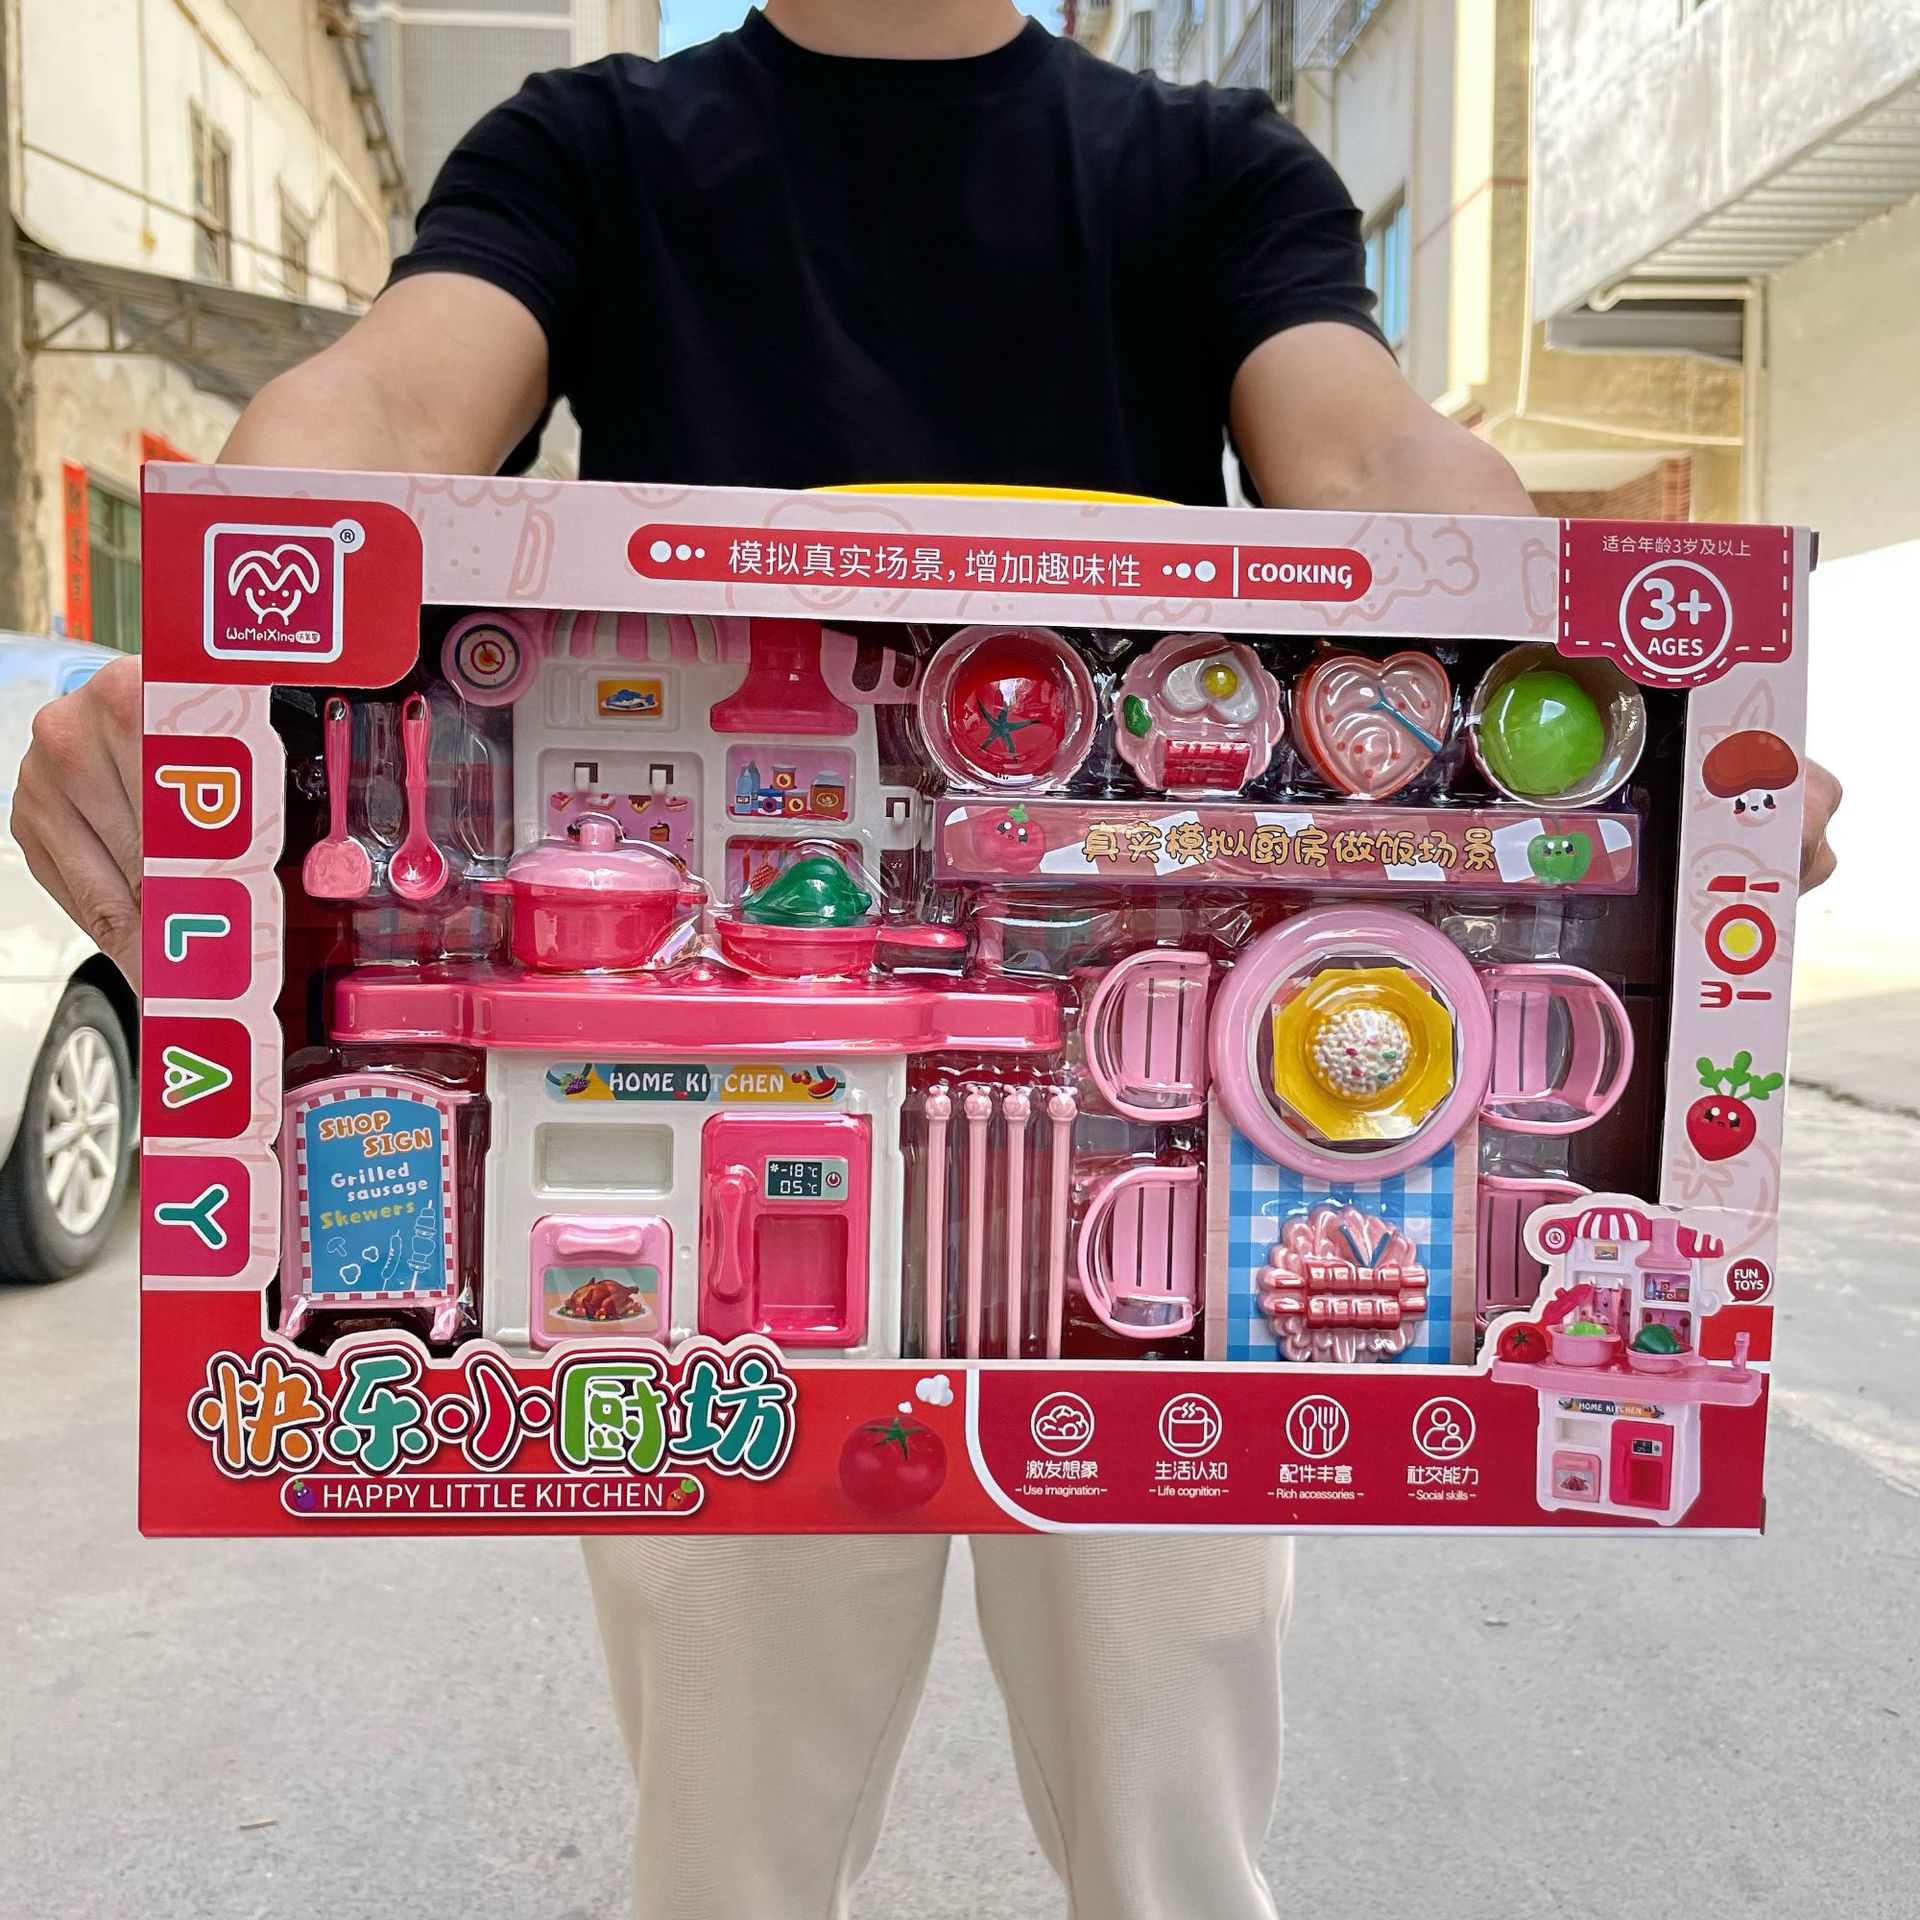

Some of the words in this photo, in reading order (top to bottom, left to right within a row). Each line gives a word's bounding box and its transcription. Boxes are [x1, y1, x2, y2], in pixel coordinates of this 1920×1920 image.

[1602, 535, 1751, 557] 适合年龄3岁及以上
[728, 539, 1142, 588] 模拟真实场景，增加趣味性
[1247, 562, 1353, 590] COOKING
[1640, 577, 1712, 631] 3+
[226, 627, 295, 643] WoMeiXing
[1647, 637, 1704, 657] AGES
[1082, 822, 1496, 871] 真实模拟厨房做饭场景
[609, 1071, 675, 1093] HOME
[685, 1071, 785, 1094] KITCHEN
[319, 1110, 391, 1141] SHOP
[363, 1127, 433, 1158] SIGN
[330, 1162, 410, 1188] Grilled
[347, 1178, 429, 1202] sausage
[319, 1202, 415, 1230] Skewers
[1734, 1268, 1759, 1279] FUN
[1734, 1280, 1764, 1291] TOYS
[198, 1355, 786, 1472] 快乐小厨坊
[1578, 1402, 1602, 1412] HOME
[1025, 1460, 1098, 1480] 激发想象
[1154, 1461, 1228, 1481] 生活认知
[1279, 1464, 1353, 1484] 配件丰富
[1407, 1466, 1479, 1485] 社交能力
[323, 1483, 421, 1509] HAPPY
[429, 1483, 526, 1508] LITTLE
[536, 1482, 663, 1508] KITCHEN
